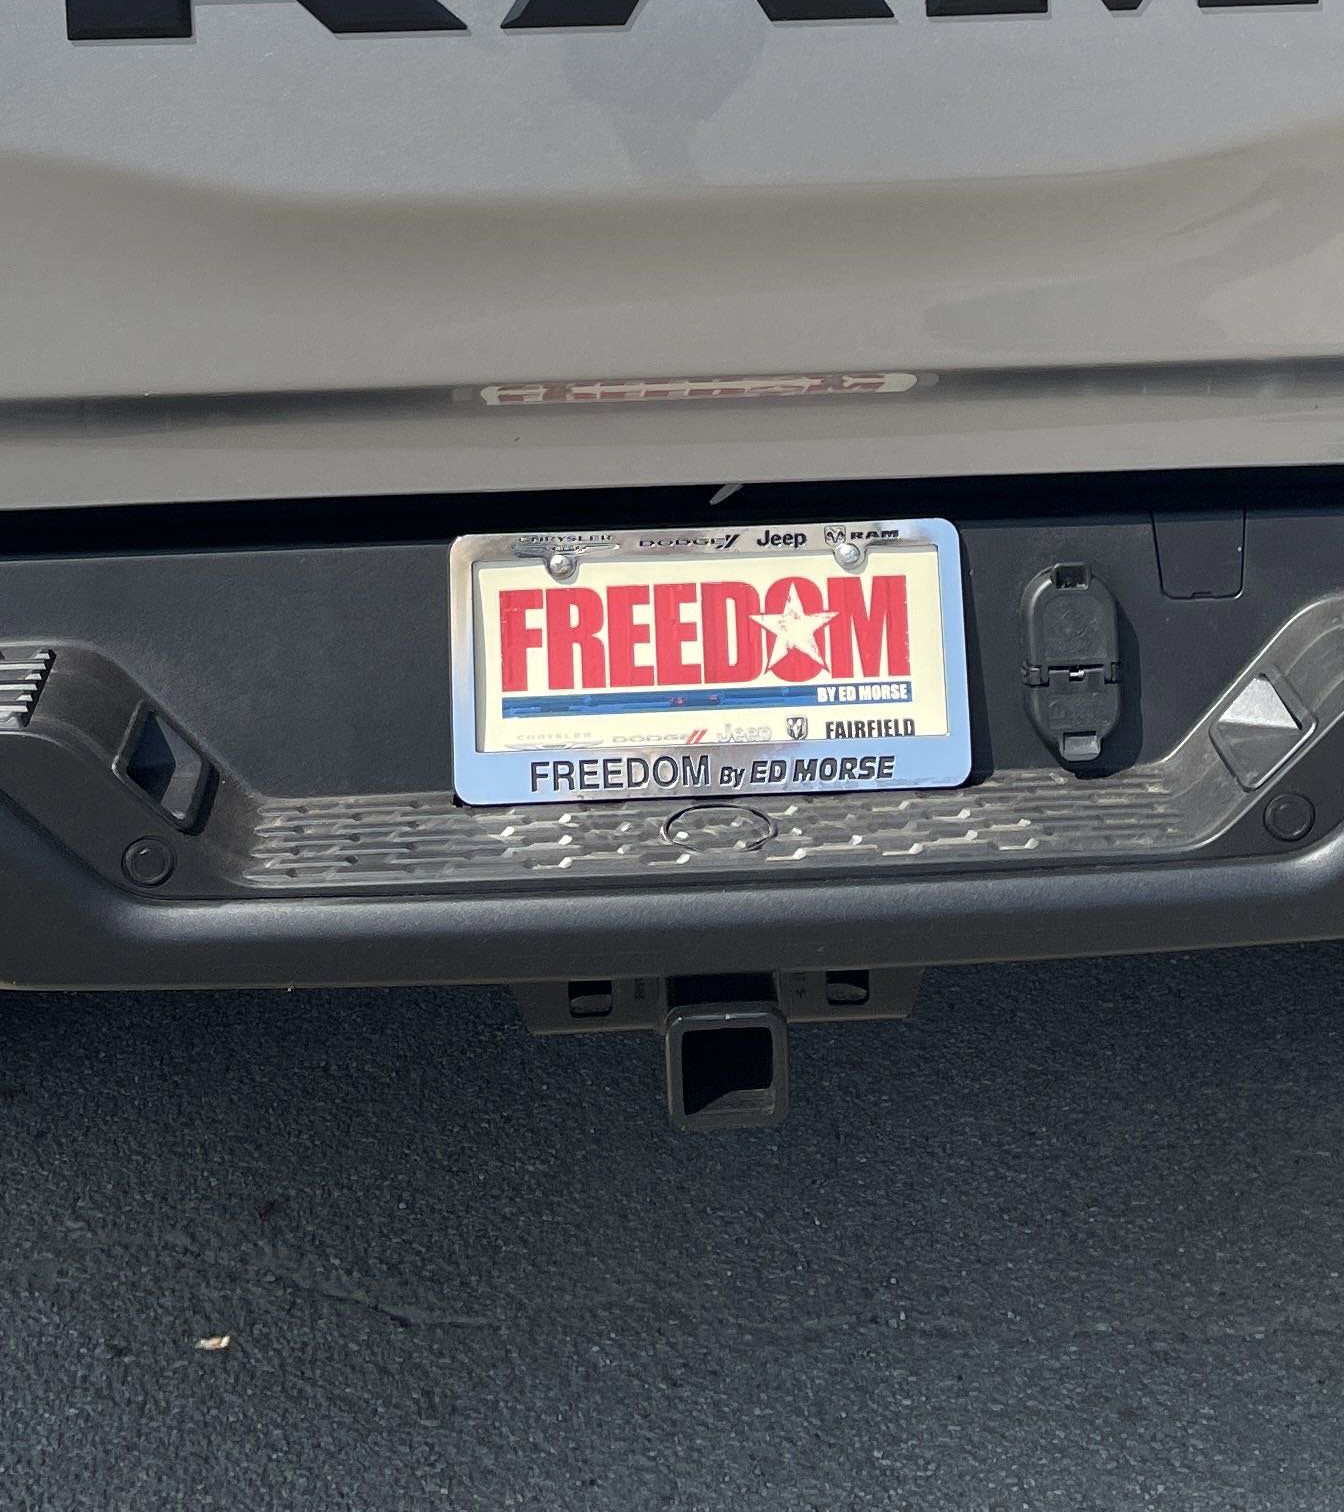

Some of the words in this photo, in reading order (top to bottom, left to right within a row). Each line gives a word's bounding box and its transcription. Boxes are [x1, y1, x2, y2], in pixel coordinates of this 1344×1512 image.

[639, 536, 727, 548] DODGE
[757, 530, 807, 548] Jeep
[850, 530, 899, 540] RAM
[499, 575, 910, 691] FREEDOM
[817, 687, 836, 702] BY
[838, 686, 856, 701] ED
[859, 683, 908, 700] MORSE
[718, 724, 772, 743] Jeep
[825, 718, 915, 740] FAIRFIELD
[531, 755, 710, 792] FREEDOM
[719, 767, 744, 788] By
[750, 760, 786, 784] ED
[793, 755, 896, 782] MORSE
